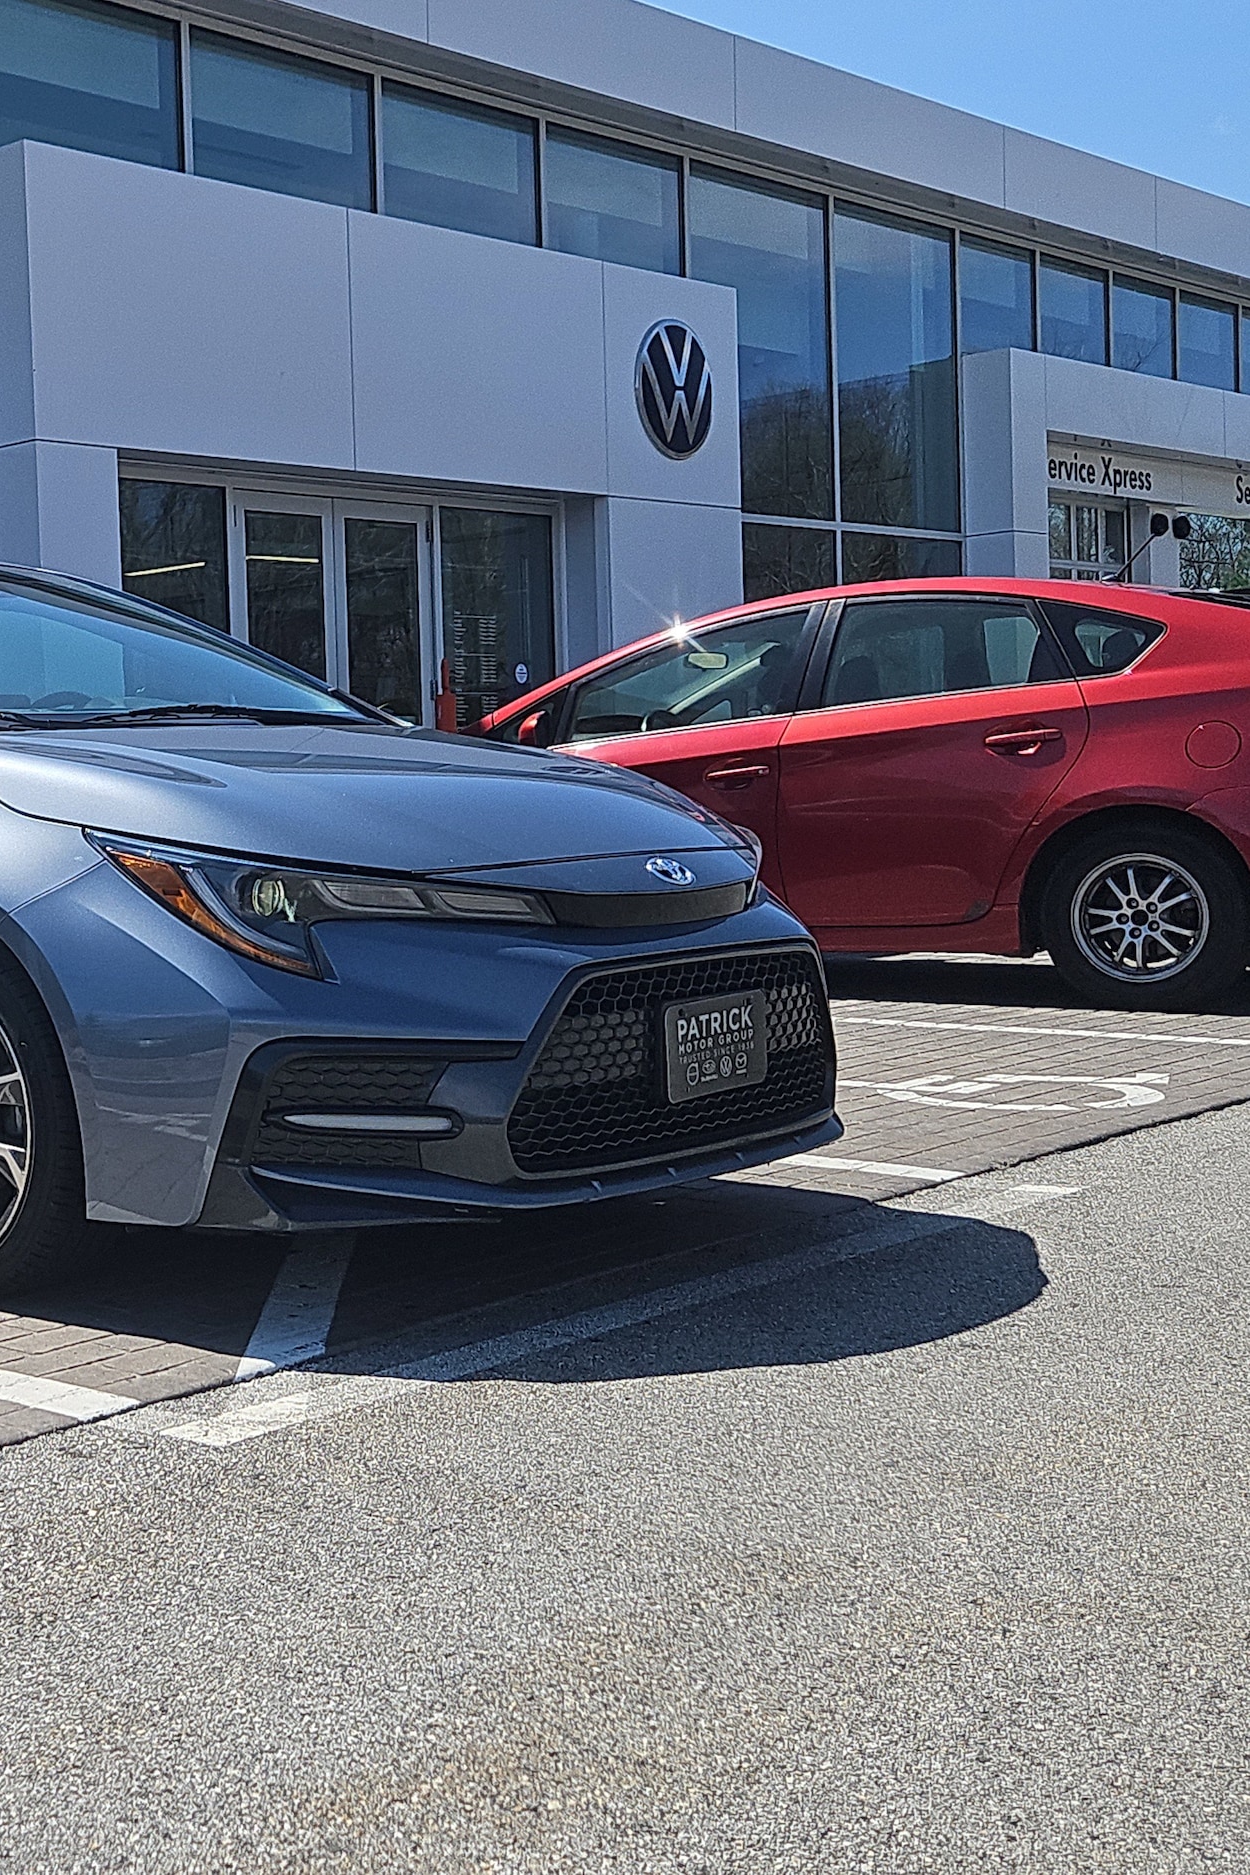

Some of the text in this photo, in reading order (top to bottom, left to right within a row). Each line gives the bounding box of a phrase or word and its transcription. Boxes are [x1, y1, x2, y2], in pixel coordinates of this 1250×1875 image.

[1101, 456, 1152, 494] Xpress
[677, 1004, 754, 1042] PATRICK
[678, 1028, 754, 1055] MOTOR GROUP
[679, 1050, 711, 1065] TRUSTED
[713, 1044, 735, 1058] SINCE
